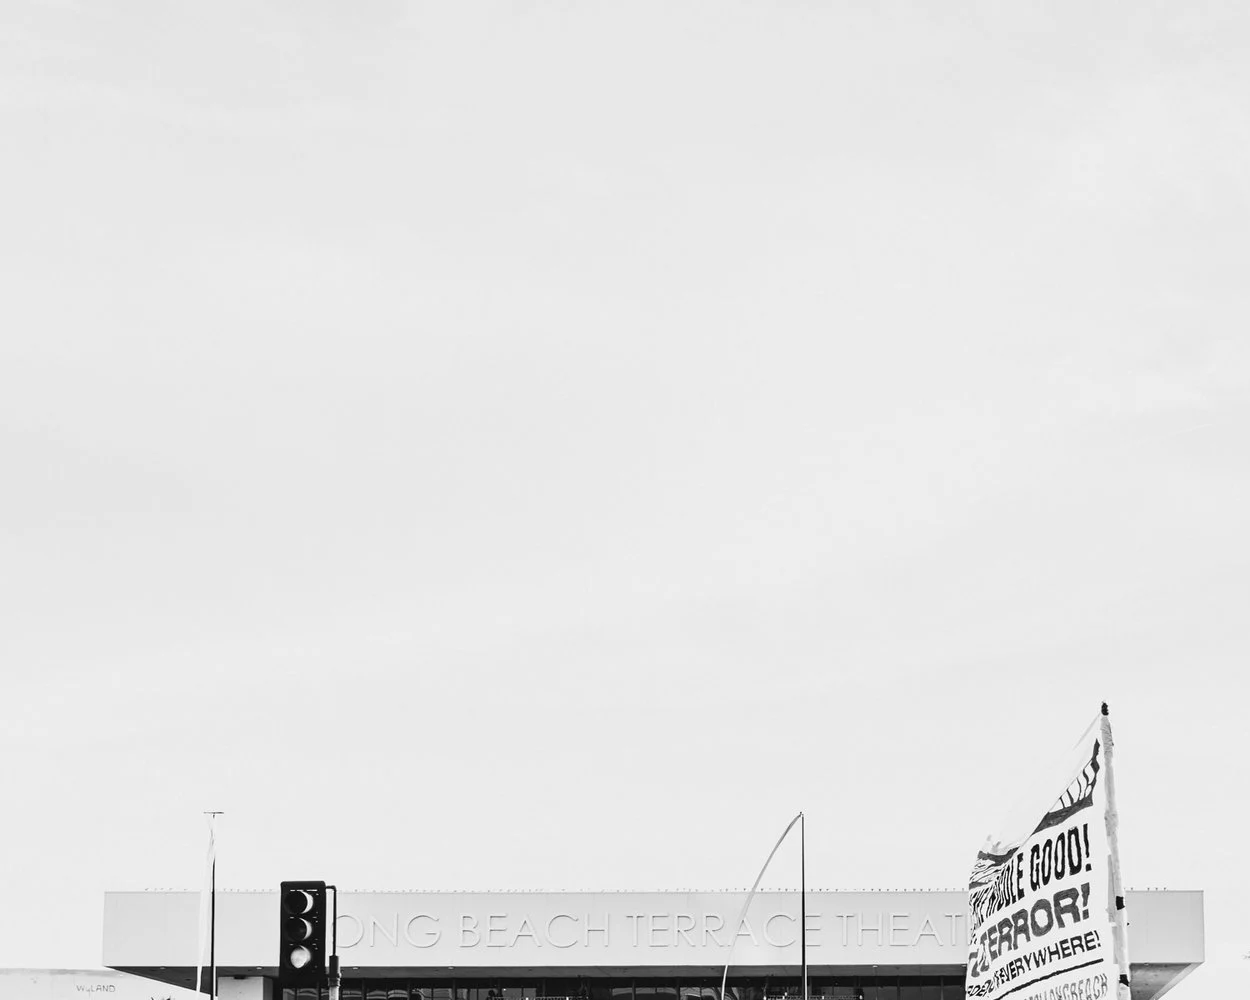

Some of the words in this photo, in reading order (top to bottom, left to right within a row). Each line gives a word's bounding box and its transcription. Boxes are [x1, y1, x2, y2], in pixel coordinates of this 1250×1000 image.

[1030, 823, 1092, 892] GOOD!
[336, 914, 442, 948] ONG
[459, 914, 610, 948] BEACH
[626, 913, 821, 948] TERRACE
[836, 913, 969, 948] THEAT
